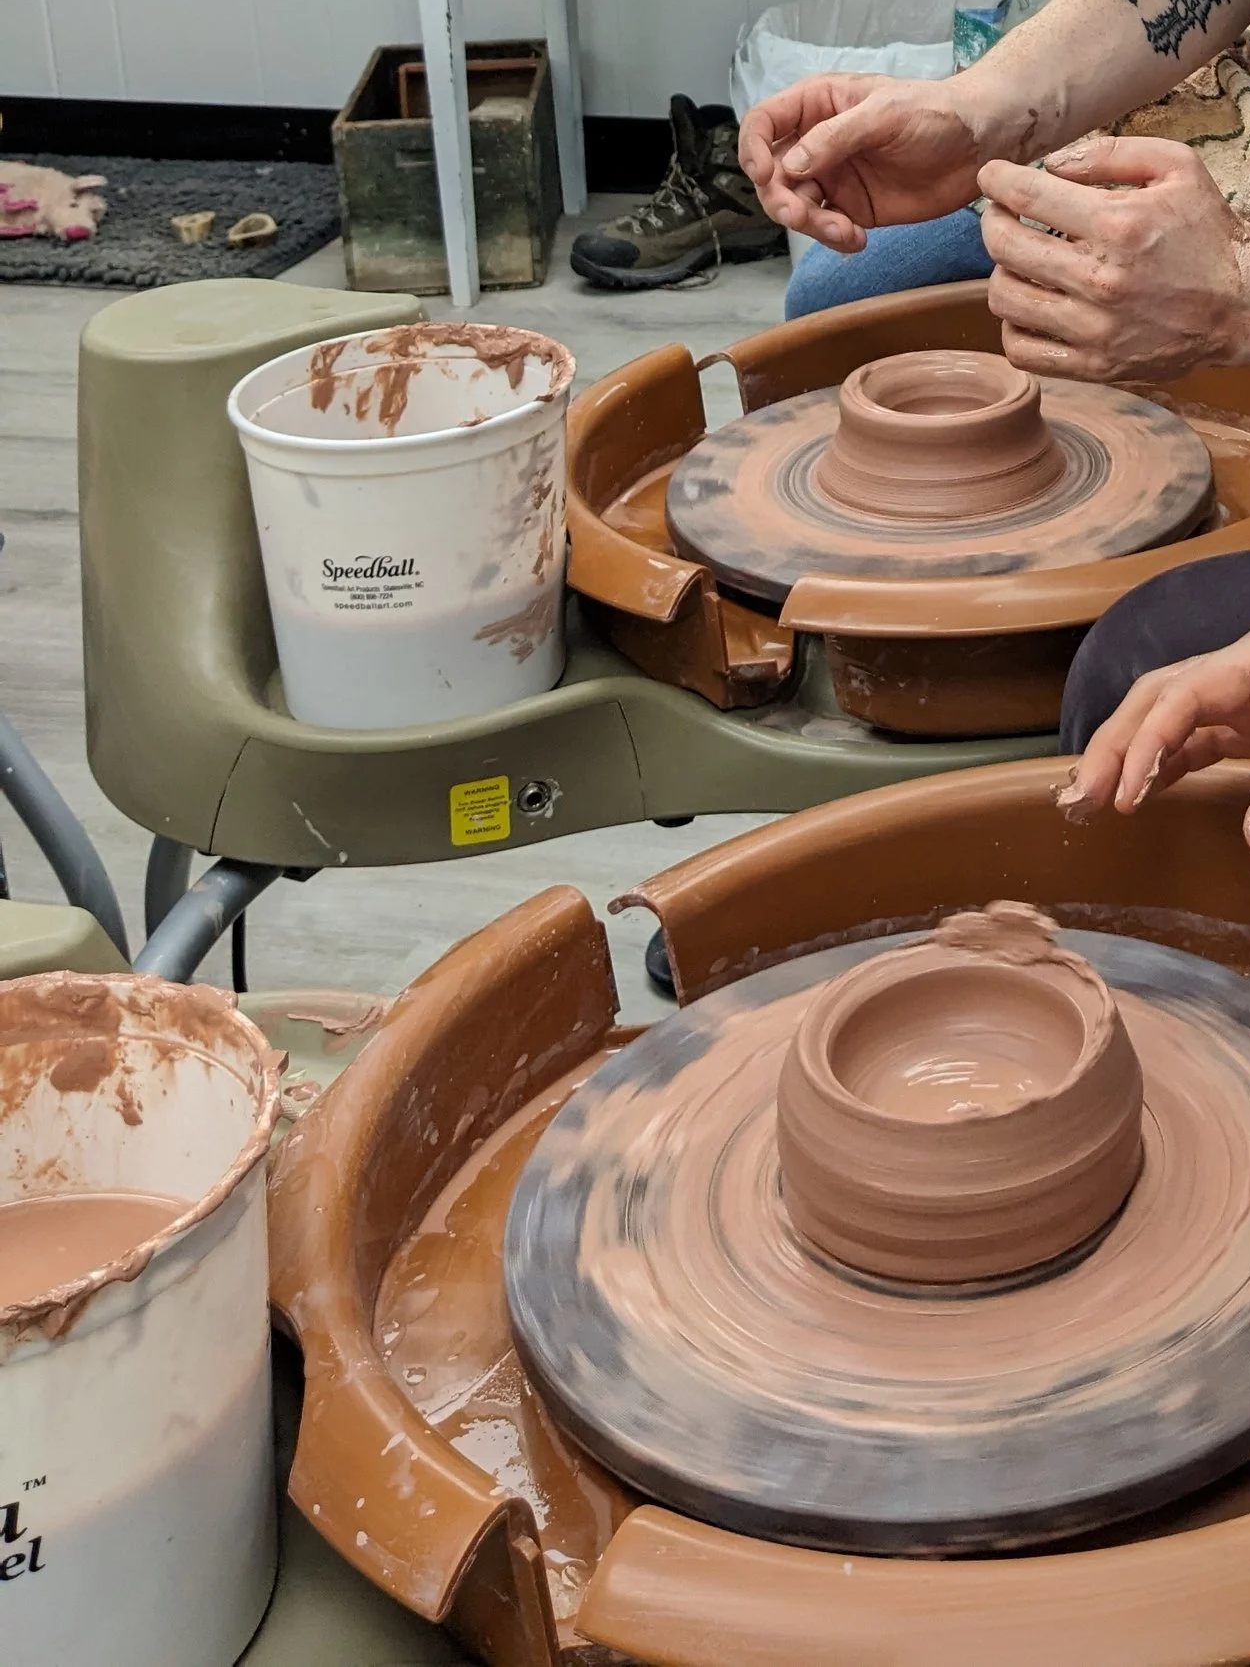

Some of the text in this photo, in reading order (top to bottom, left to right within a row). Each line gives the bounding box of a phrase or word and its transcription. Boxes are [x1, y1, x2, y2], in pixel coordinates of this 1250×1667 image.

[334, 600, 413, 610] speedballart.com
[464, 784, 500, 795] WARNING
[465, 824, 501, 835] WARNING
